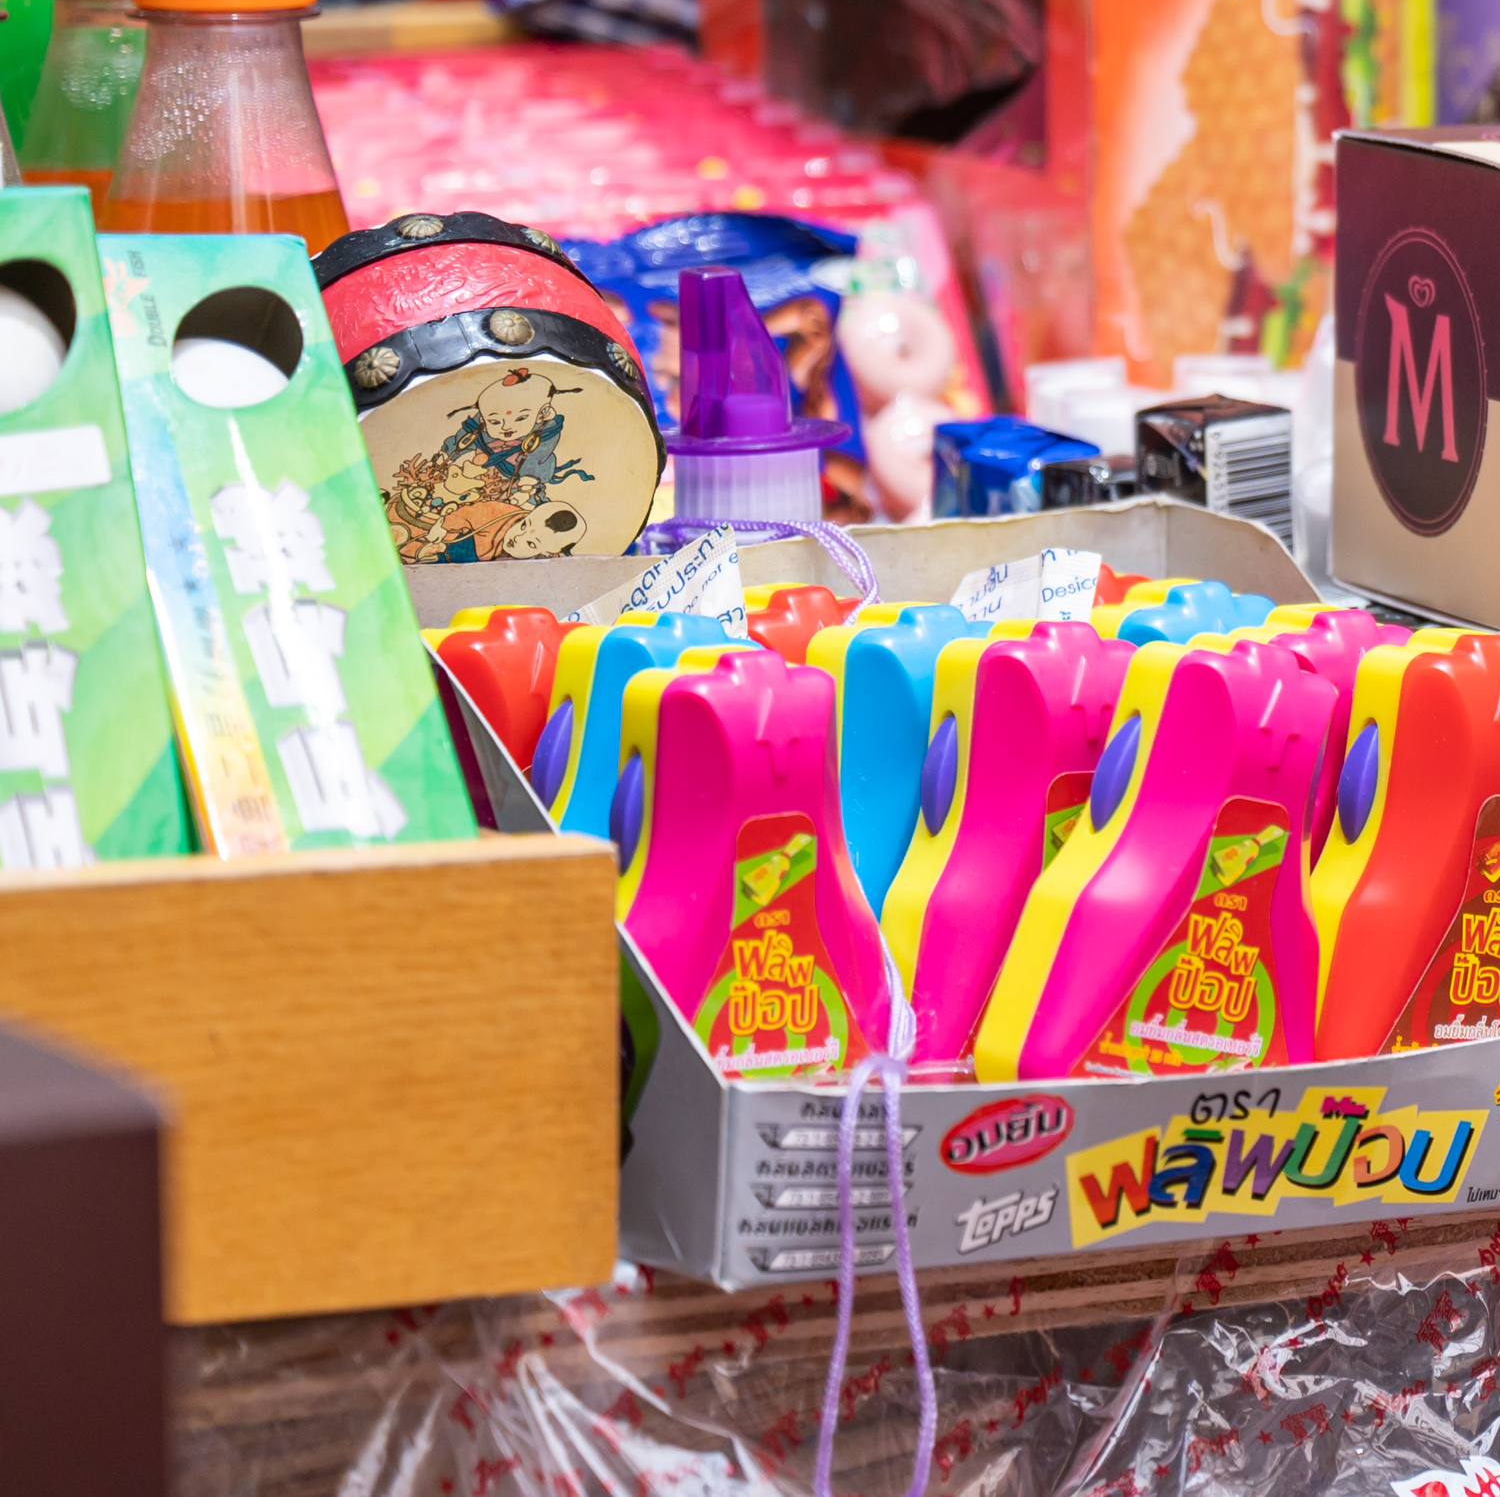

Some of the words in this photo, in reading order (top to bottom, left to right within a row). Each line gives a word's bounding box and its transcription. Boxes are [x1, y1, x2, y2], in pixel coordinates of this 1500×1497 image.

[1383, 292, 1459, 463] M
[732, 930, 816, 988] ฟลิพ
[1187, 908, 1260, 976] ฟลิพ
[947, 1099, 1069, 1164] อมยิ้ม
[1190, 1086, 1282, 1126] ตรา
